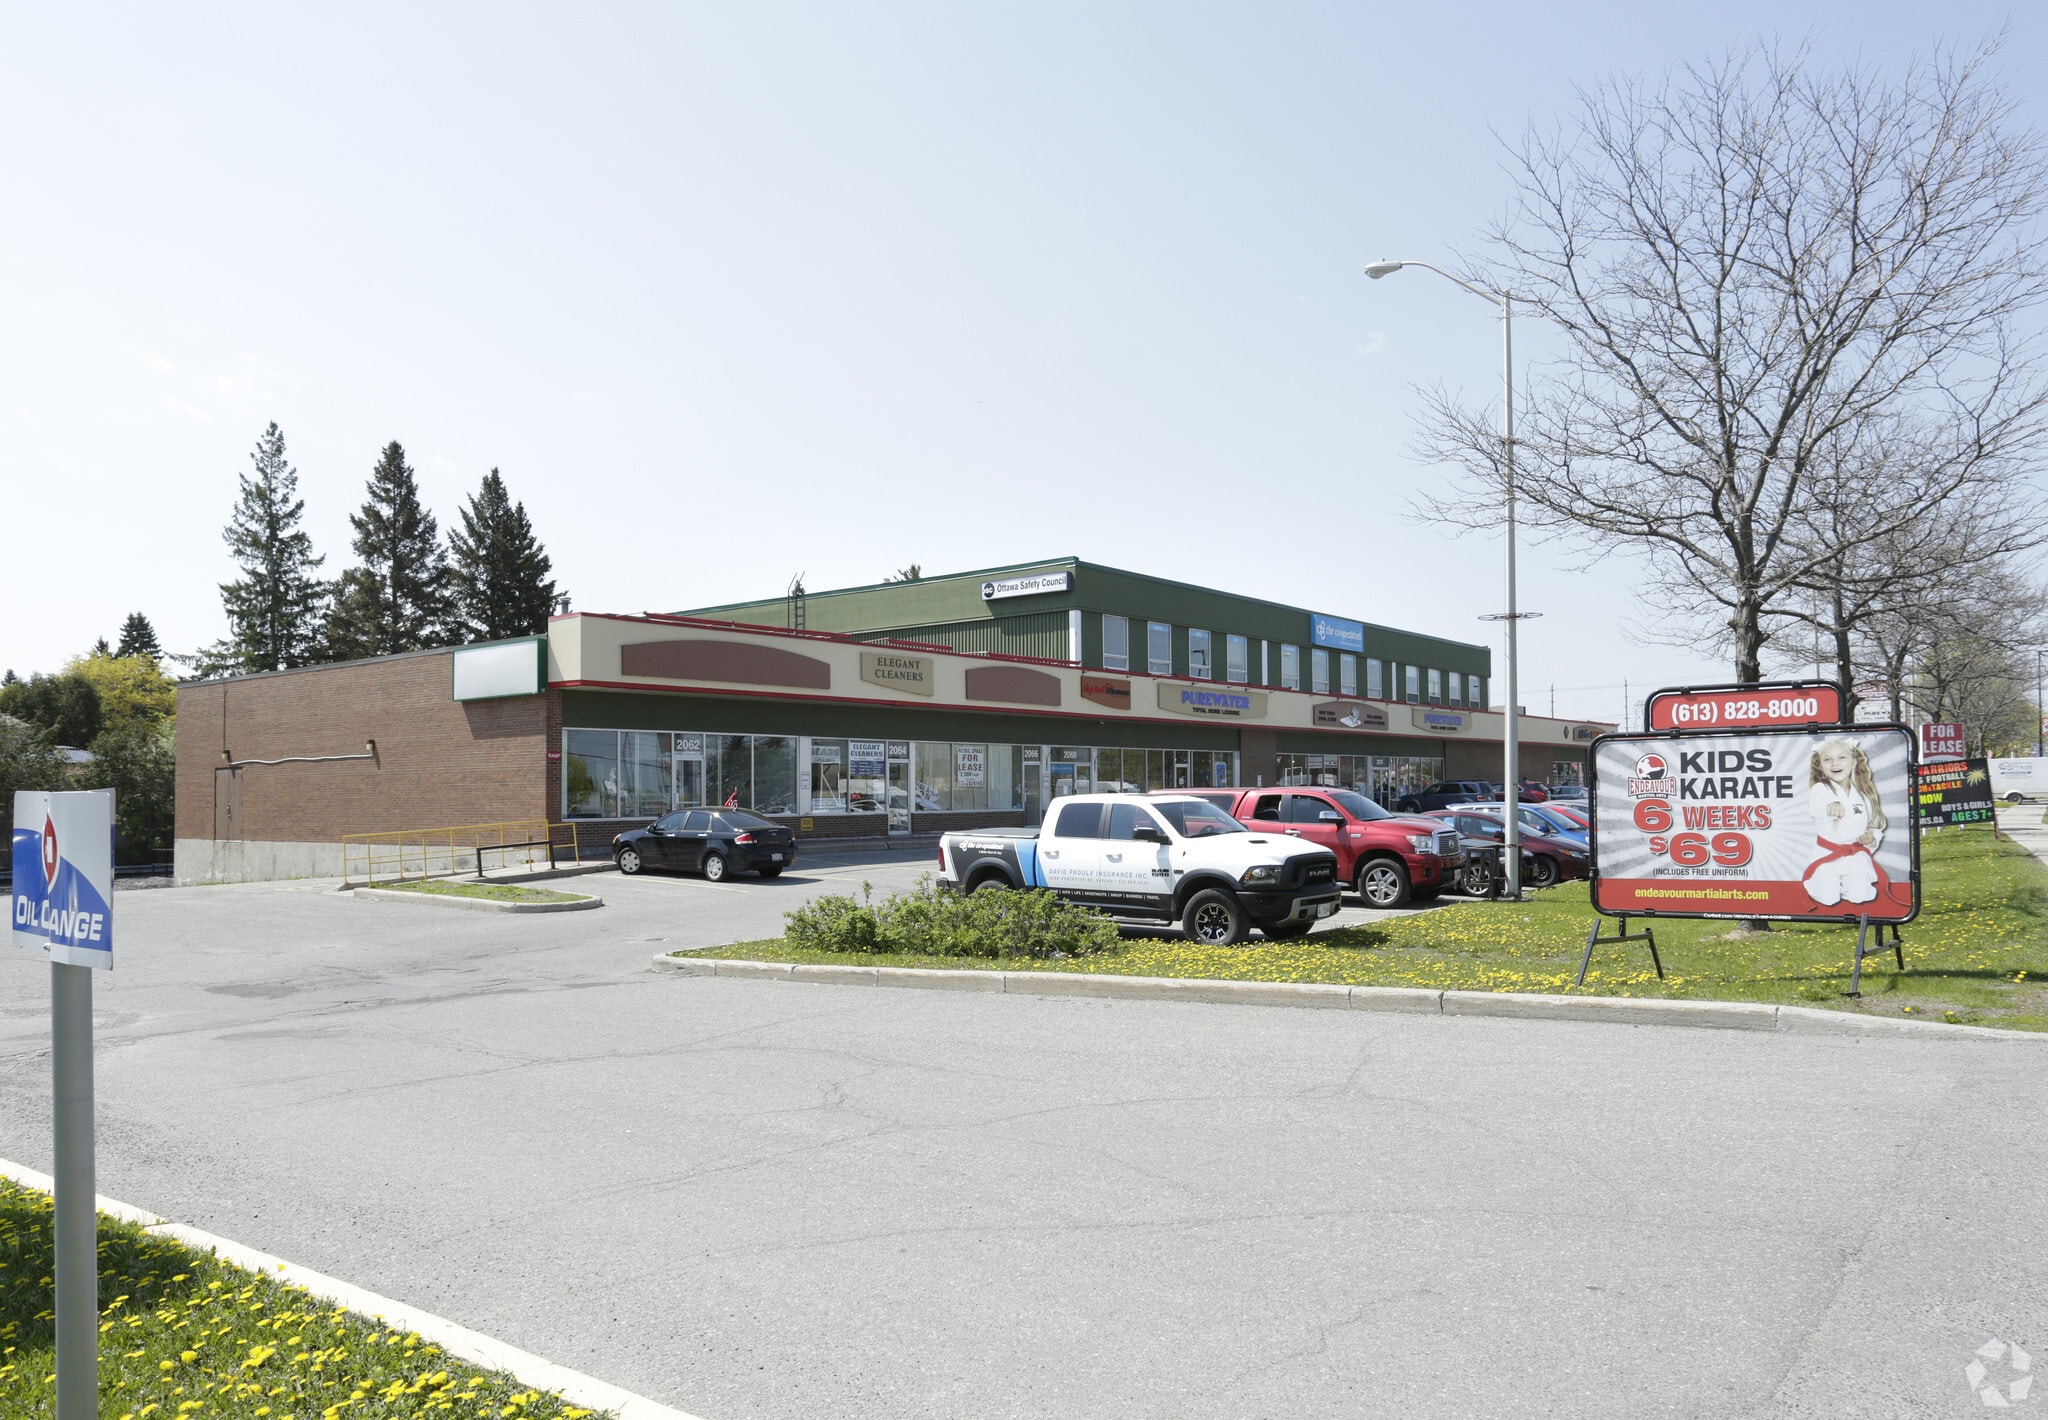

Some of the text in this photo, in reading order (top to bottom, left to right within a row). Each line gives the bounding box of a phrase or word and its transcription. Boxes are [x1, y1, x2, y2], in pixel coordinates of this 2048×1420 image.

[997, 576, 1067, 593] Ottawa Safety Council
[877, 657, 920, 670] ELEGANT
[875, 669, 923, 681] CLEANERS
[1181, 690, 1250, 709] PUREWATER
[1671, 698, 1818, 724] (613) 828-8000
[1930, 725, 1955, 737] FOR
[676, 739, 700, 750] 2062
[852, 743, 881, 751] ELEGANT
[889, 745, 907, 755] 2064
[1923, 740, 1963, 753] LEASE
[962, 754, 978, 762] FOR
[1024, 749, 1039, 758] 2066
[958, 763, 983, 772] LEASE
[1680, 749, 1773, 774] KIDS
[1926, 772, 1966, 784] FOOTBALL
[1629, 777, 1676, 795] ENDEAVOUR
[1680, 776, 1794, 800] KARATE
[1920, 793, 1943, 804] NOW
[1941, 800, 1993, 812] BOYS & GIRLS
[1633, 798, 1772, 833] 6 WEEKS
[1951, 809, 1993, 822] AGES 7+
[1649, 832, 1753, 867] $69
[1095, 870, 1134, 878] INSURANCE
[1653, 868, 1749, 878] (INCLUDES FREE UNIFORM)
[1635, 887, 1769, 900] endeavourmartialarts.com
[16, 895, 39, 926] OIL
